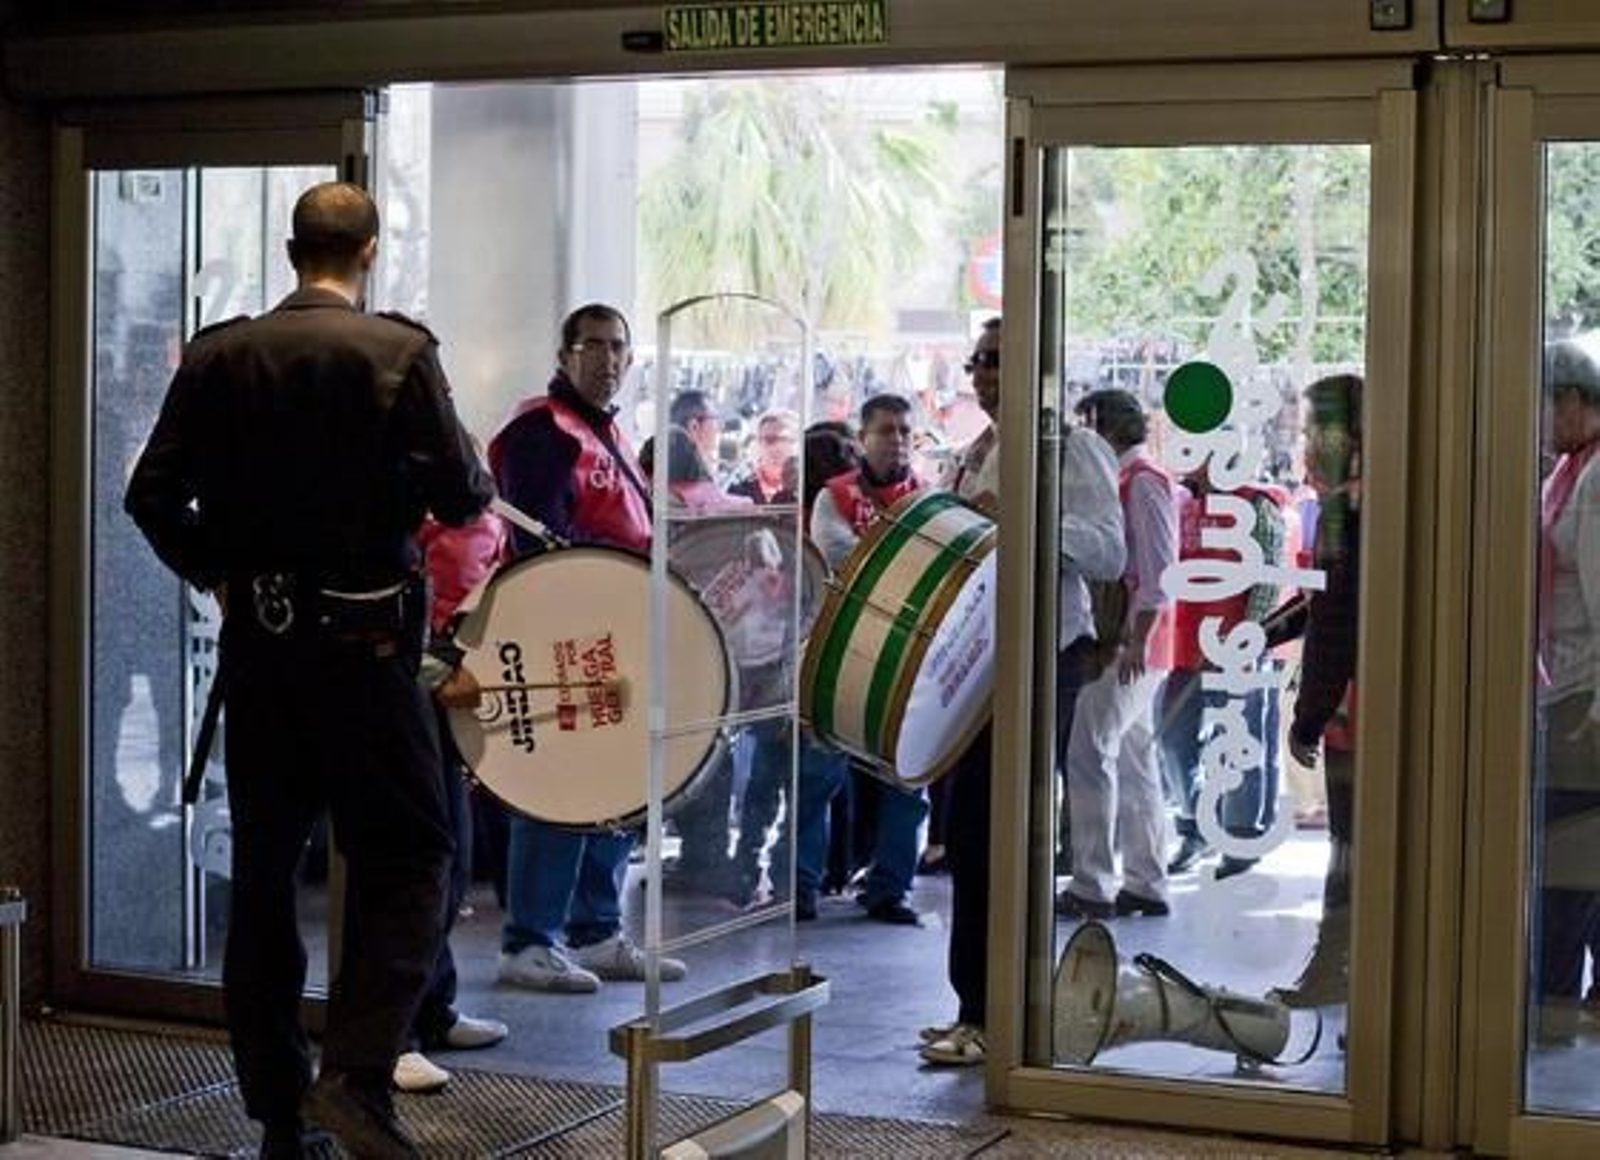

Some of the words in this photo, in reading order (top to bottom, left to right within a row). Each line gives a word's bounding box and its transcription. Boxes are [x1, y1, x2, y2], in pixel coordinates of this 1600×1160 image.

[668, 9, 732, 49] SALIDA
[735, 9, 760, 46] DE
[765, 3, 884, 45] EMERGENCIA
[581, 647, 607, 729] HUEGA
[596, 632, 623, 725] GERAL
